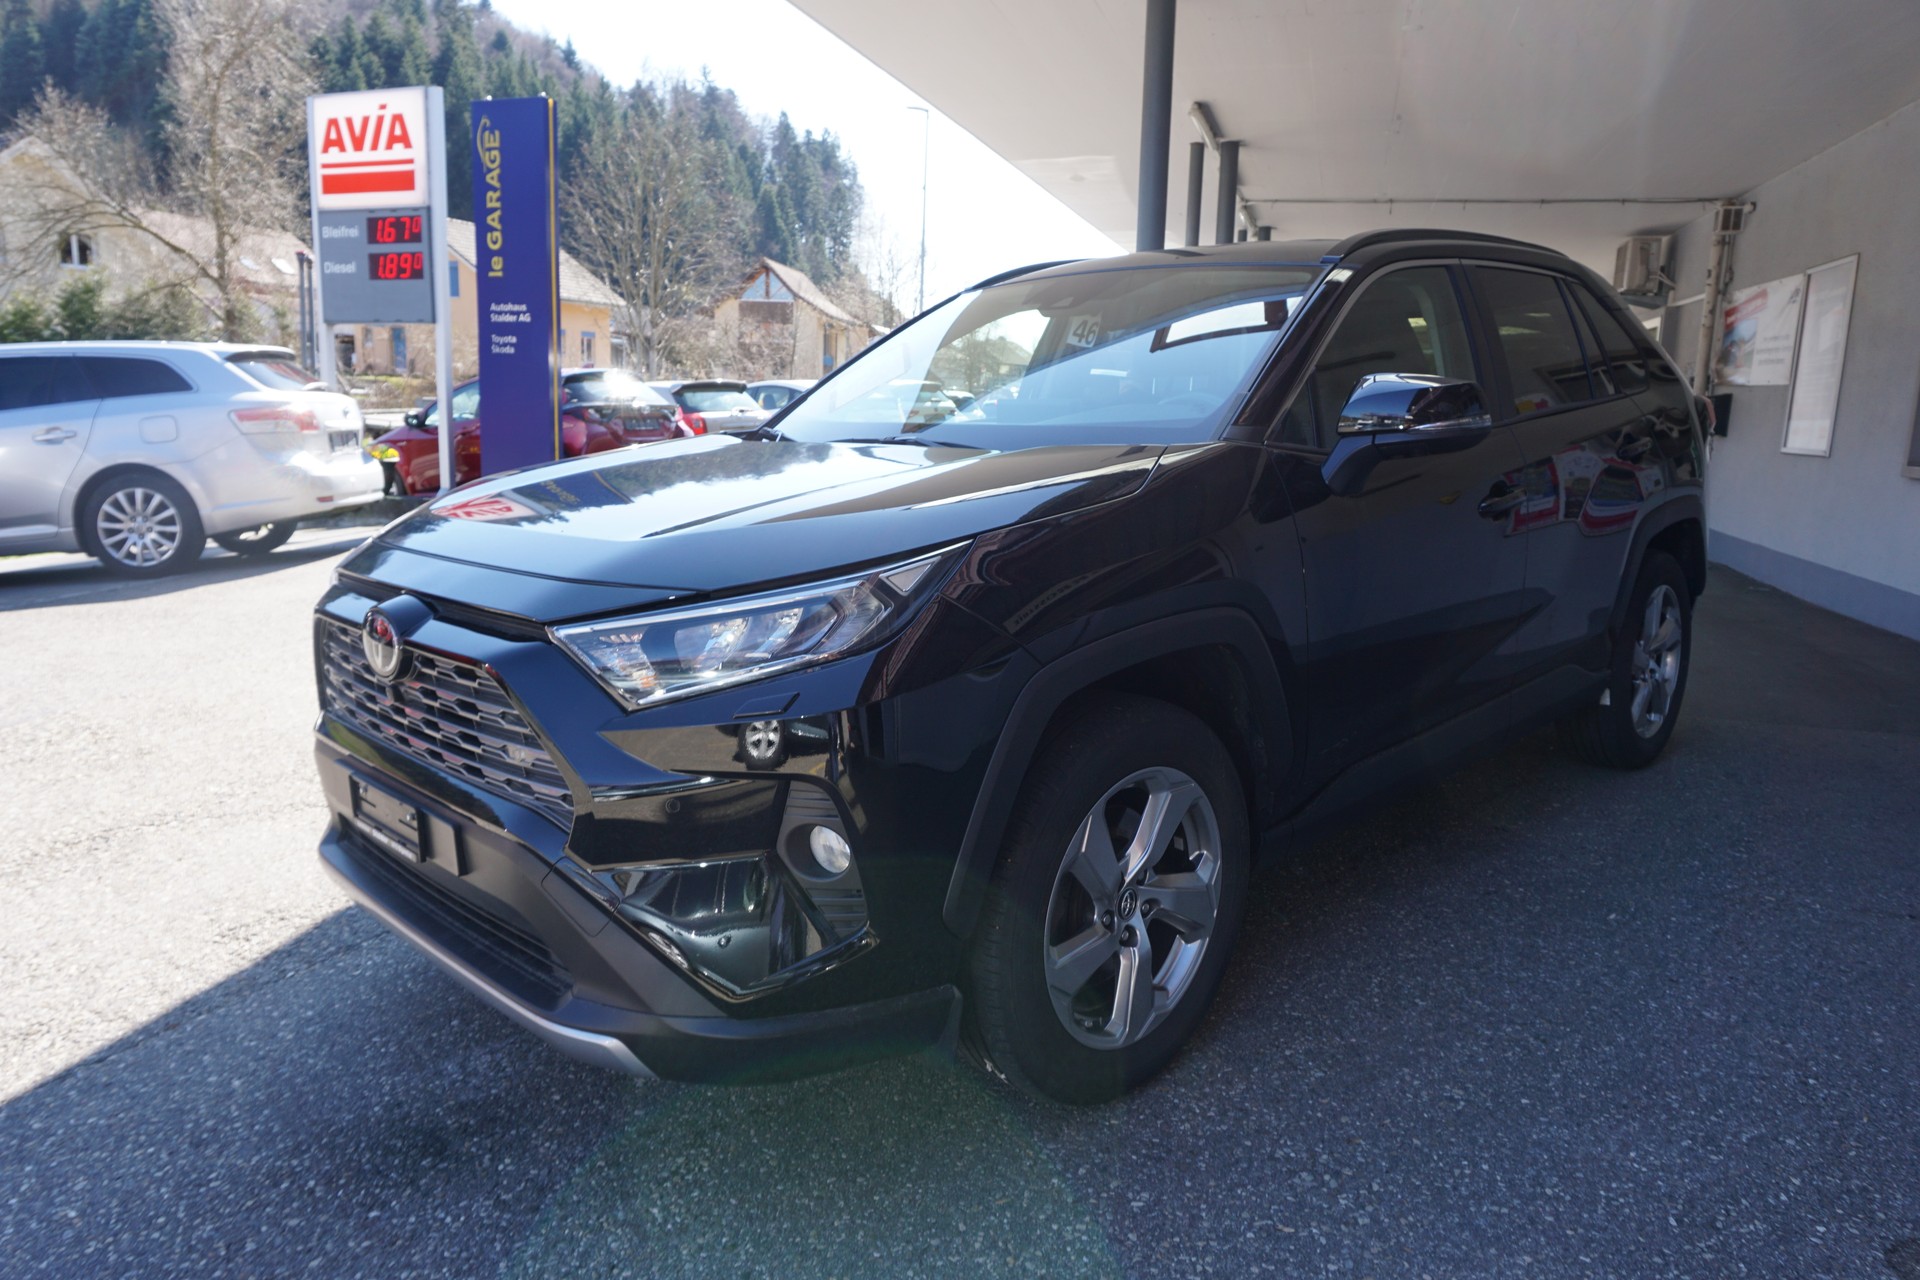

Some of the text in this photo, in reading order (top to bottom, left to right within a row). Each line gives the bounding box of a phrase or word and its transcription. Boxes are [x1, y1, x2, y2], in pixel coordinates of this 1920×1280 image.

[485, 129, 504, 277] le GARAGE
[322, 225, 359, 238] Bleifrei
[324, 261, 356, 274] Diesel
[490, 302, 527, 311] Autohaus
[490, 312, 531, 322] Stalder AG
[1072, 319, 1099, 345] 46
[491, 334, 517, 345] Toyota
